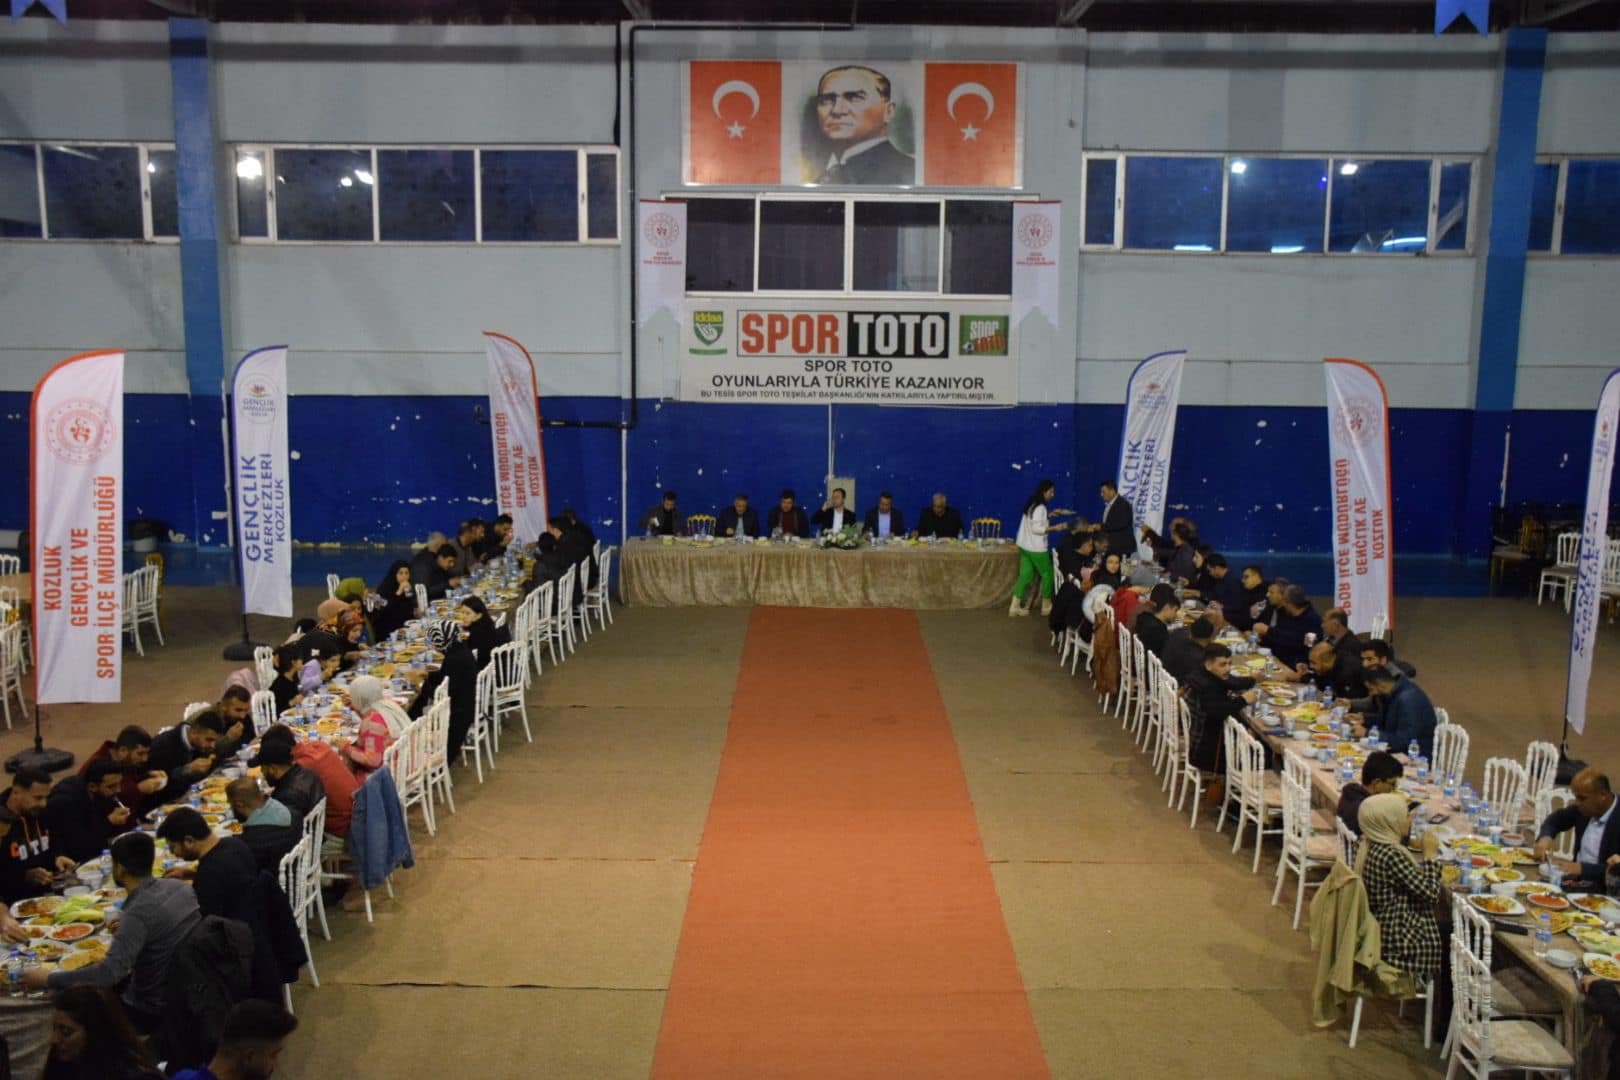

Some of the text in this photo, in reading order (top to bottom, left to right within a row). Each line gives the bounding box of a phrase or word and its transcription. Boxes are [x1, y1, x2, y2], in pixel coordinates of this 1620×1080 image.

[741, 313, 946, 356] SPOR TOTO
[804, 359, 893, 373] SPOR TOTO
[700, 390, 712, 398] BU
[736, 390, 758, 398] SPOR
[760, 390, 780, 399] TOTO
[711, 373, 985, 390] OYUNLARIYLA TÜRKİYE KAZANIYOR
[1121, 439, 1142, 503] NÇLİK
[1150, 459, 1166, 512] KOZLUK
[240, 456, 261, 562] GENÇLİK
[274, 479, 285, 542] KOZLUK
[43, 545, 62, 611] KOZLUK
[67, 527, 93, 627] GENÇLİK VE
[94, 476, 119, 679] SPOR İLÇE MÜDÜRLÜĞÜ
